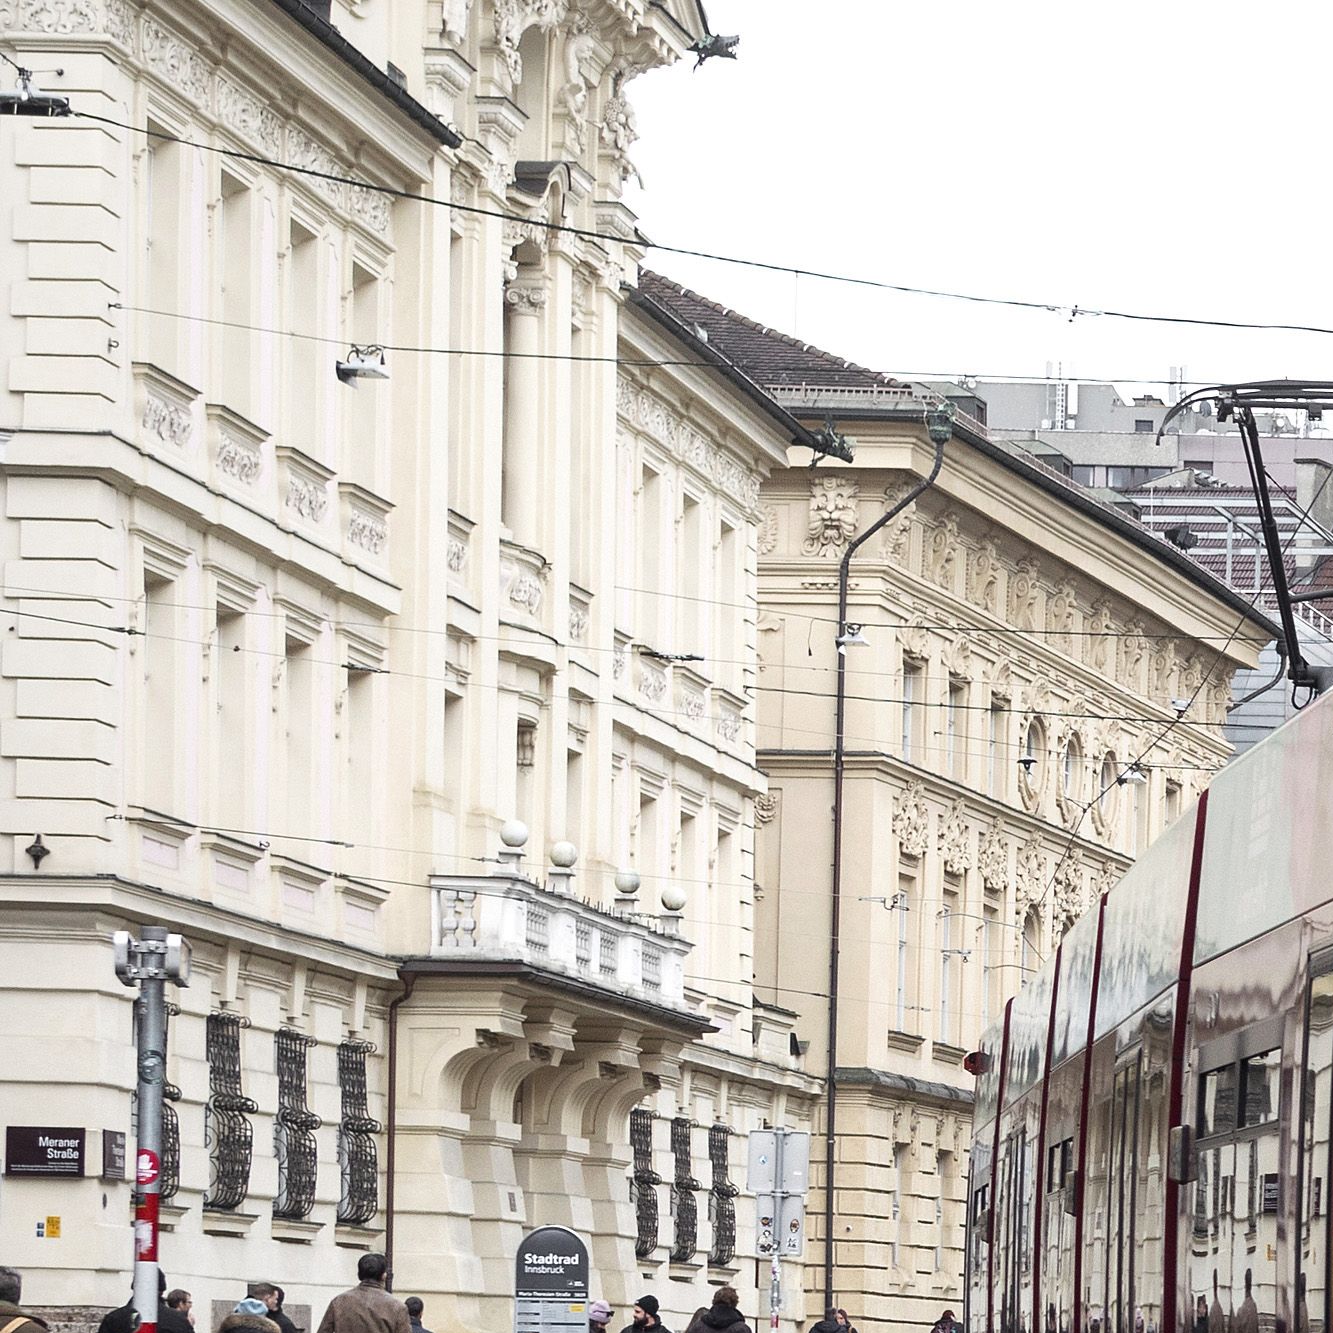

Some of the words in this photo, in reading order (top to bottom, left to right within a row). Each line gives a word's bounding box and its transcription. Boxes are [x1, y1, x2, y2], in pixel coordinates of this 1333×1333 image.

[38, 1136, 80, 1148] Meraner
[46, 1148, 80, 1160] Straße
[524, 1252, 580, 1266] Stadtrad
[524, 1265, 565, 1274] Innsbruck
